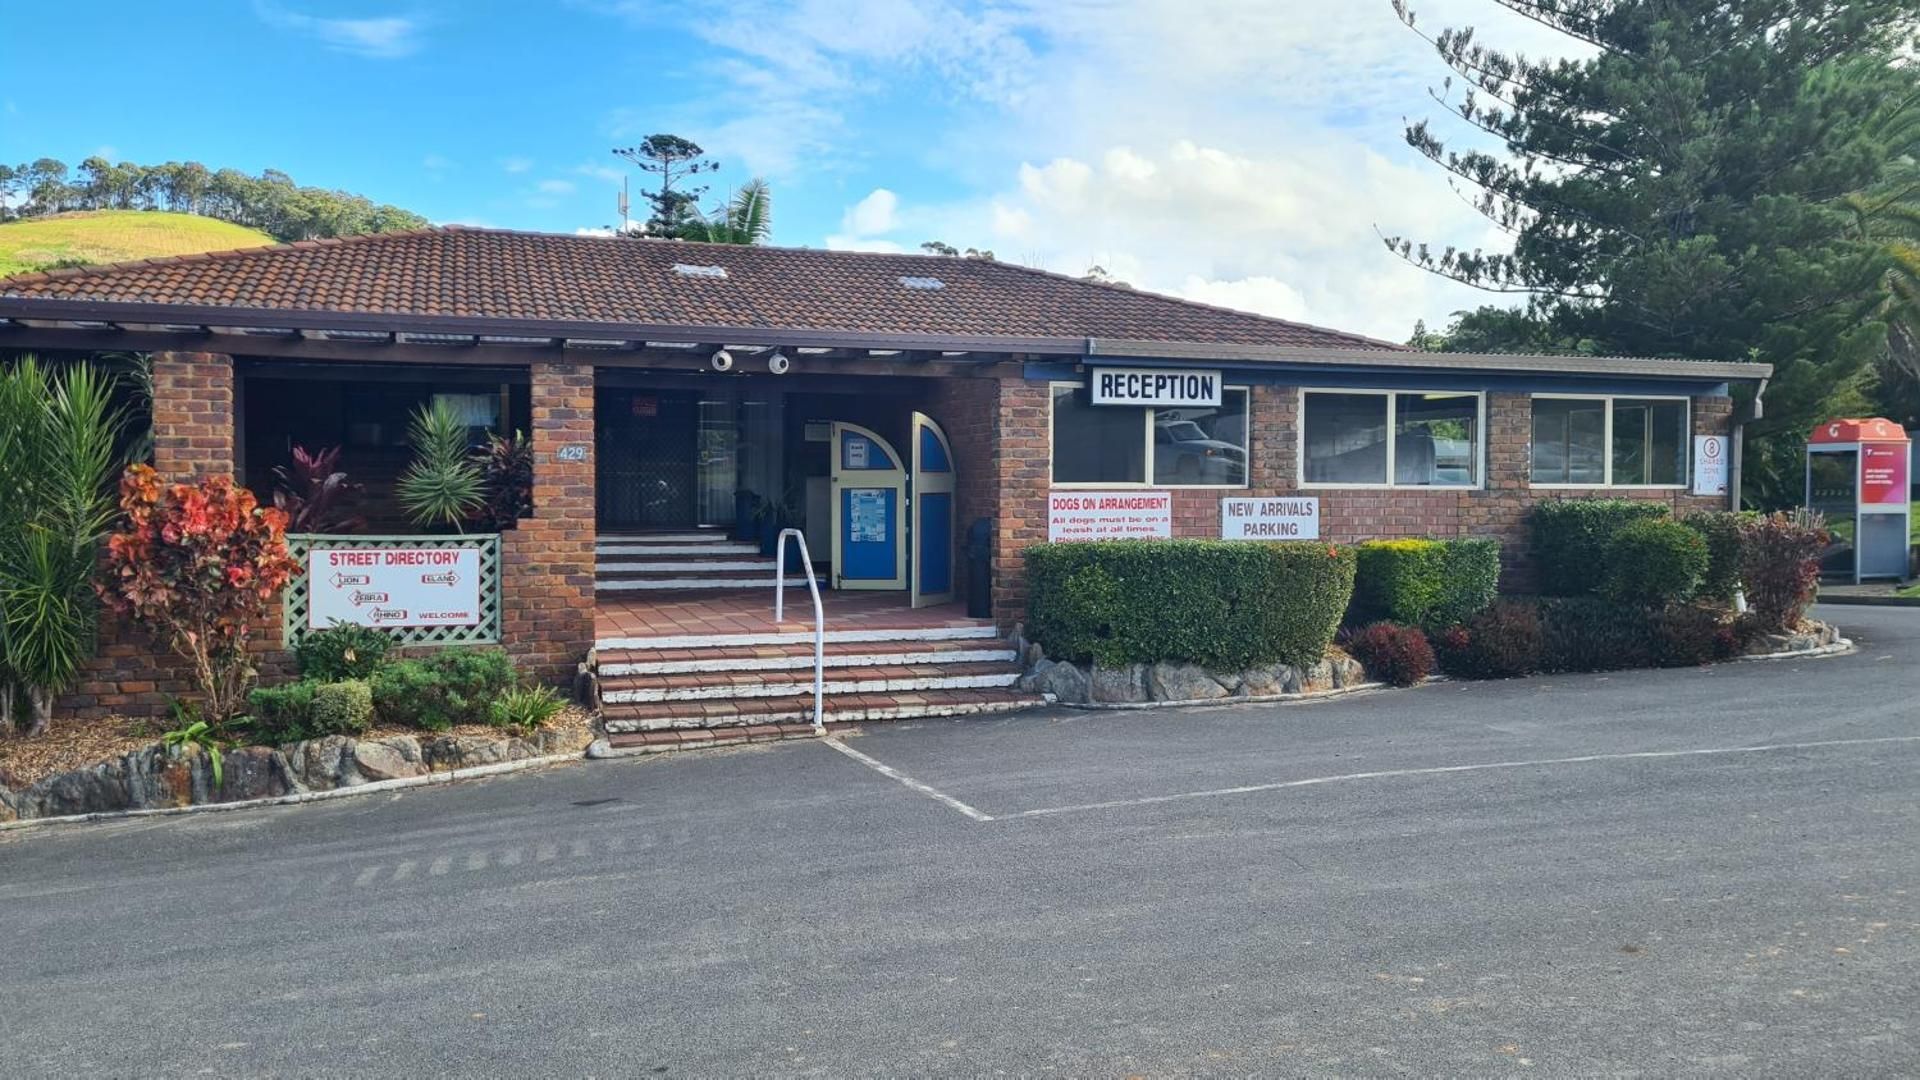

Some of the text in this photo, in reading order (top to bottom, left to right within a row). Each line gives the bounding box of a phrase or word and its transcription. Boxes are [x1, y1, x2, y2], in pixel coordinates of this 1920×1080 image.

[1101, 373, 1213, 400] RECEPTION
[560, 447, 583, 460] 429
[1053, 497, 1168, 510] DOGS ON ARRANGEMENT
[1228, 502, 1313, 517] NEW ARRIVALS
[1052, 516, 1066, 524] All
[1069, 516, 1096, 526] dogs
[1062, 525, 1093, 534] leash
[1096, 525, 1107, 533] at
[1110, 525, 1123, 533] all
[1243, 522, 1298, 536] PARKING
[330, 551, 460, 566] STREET DIRECTORY
[339, 576, 360, 585] LION
[427, 574, 456, 583] ELAND
[353, 593, 383, 602] ZEBRA
